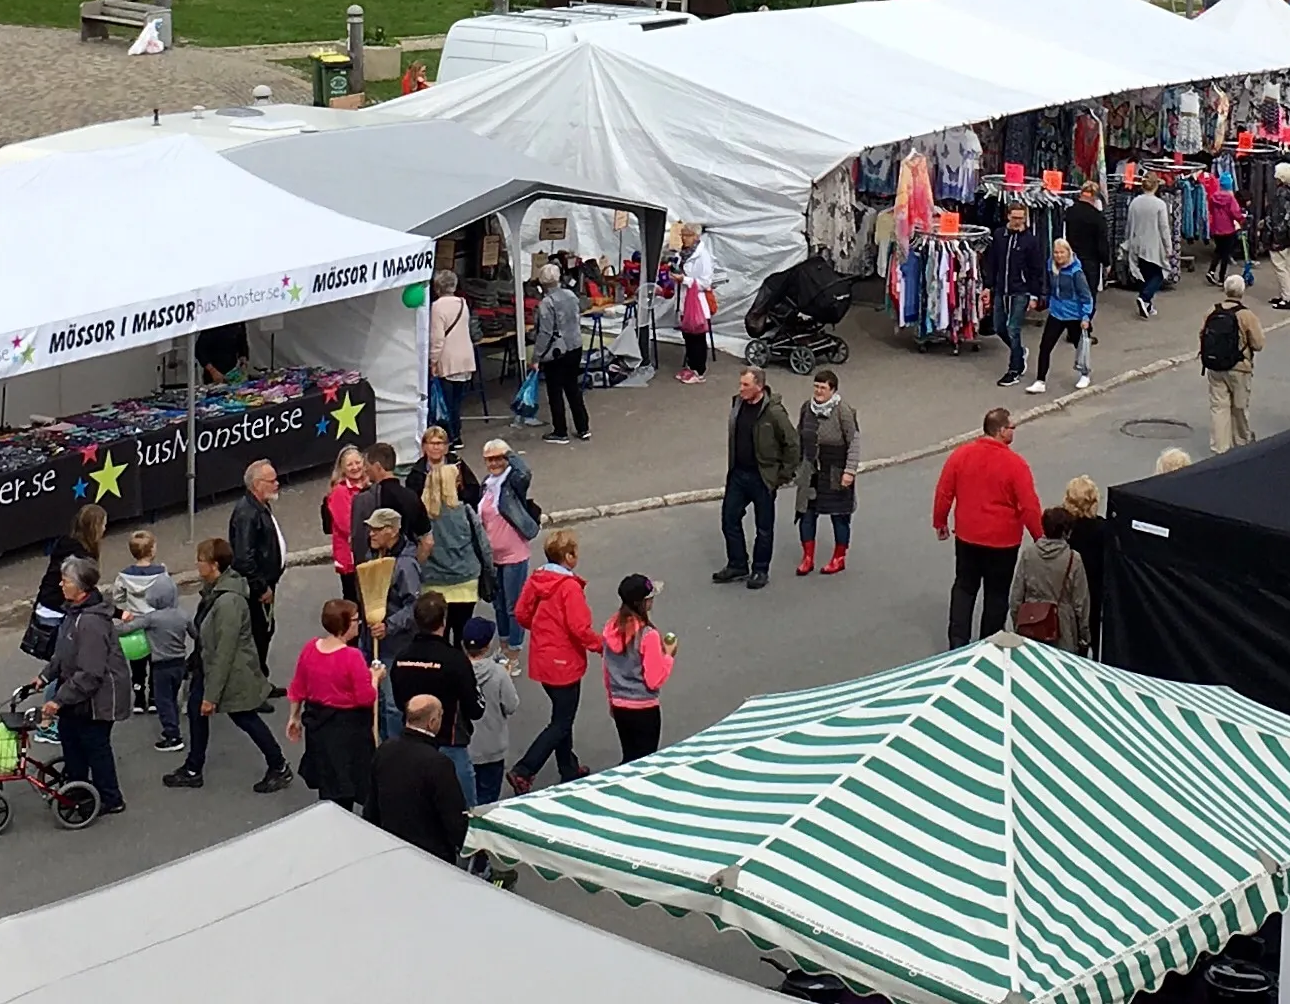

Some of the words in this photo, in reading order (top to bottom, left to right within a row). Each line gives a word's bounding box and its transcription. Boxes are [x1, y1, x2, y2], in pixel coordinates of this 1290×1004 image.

[312, 263, 368, 293] MÖSSOR
[372, 267, 377, 281] I
[382, 250, 434, 279] MASSOR
[196, 286, 280, 315] BusMonster.se
[49, 319, 115, 354] MÖSSOR
[120, 316, 127, 337] I
[132, 300, 195, 334] MASSOR
